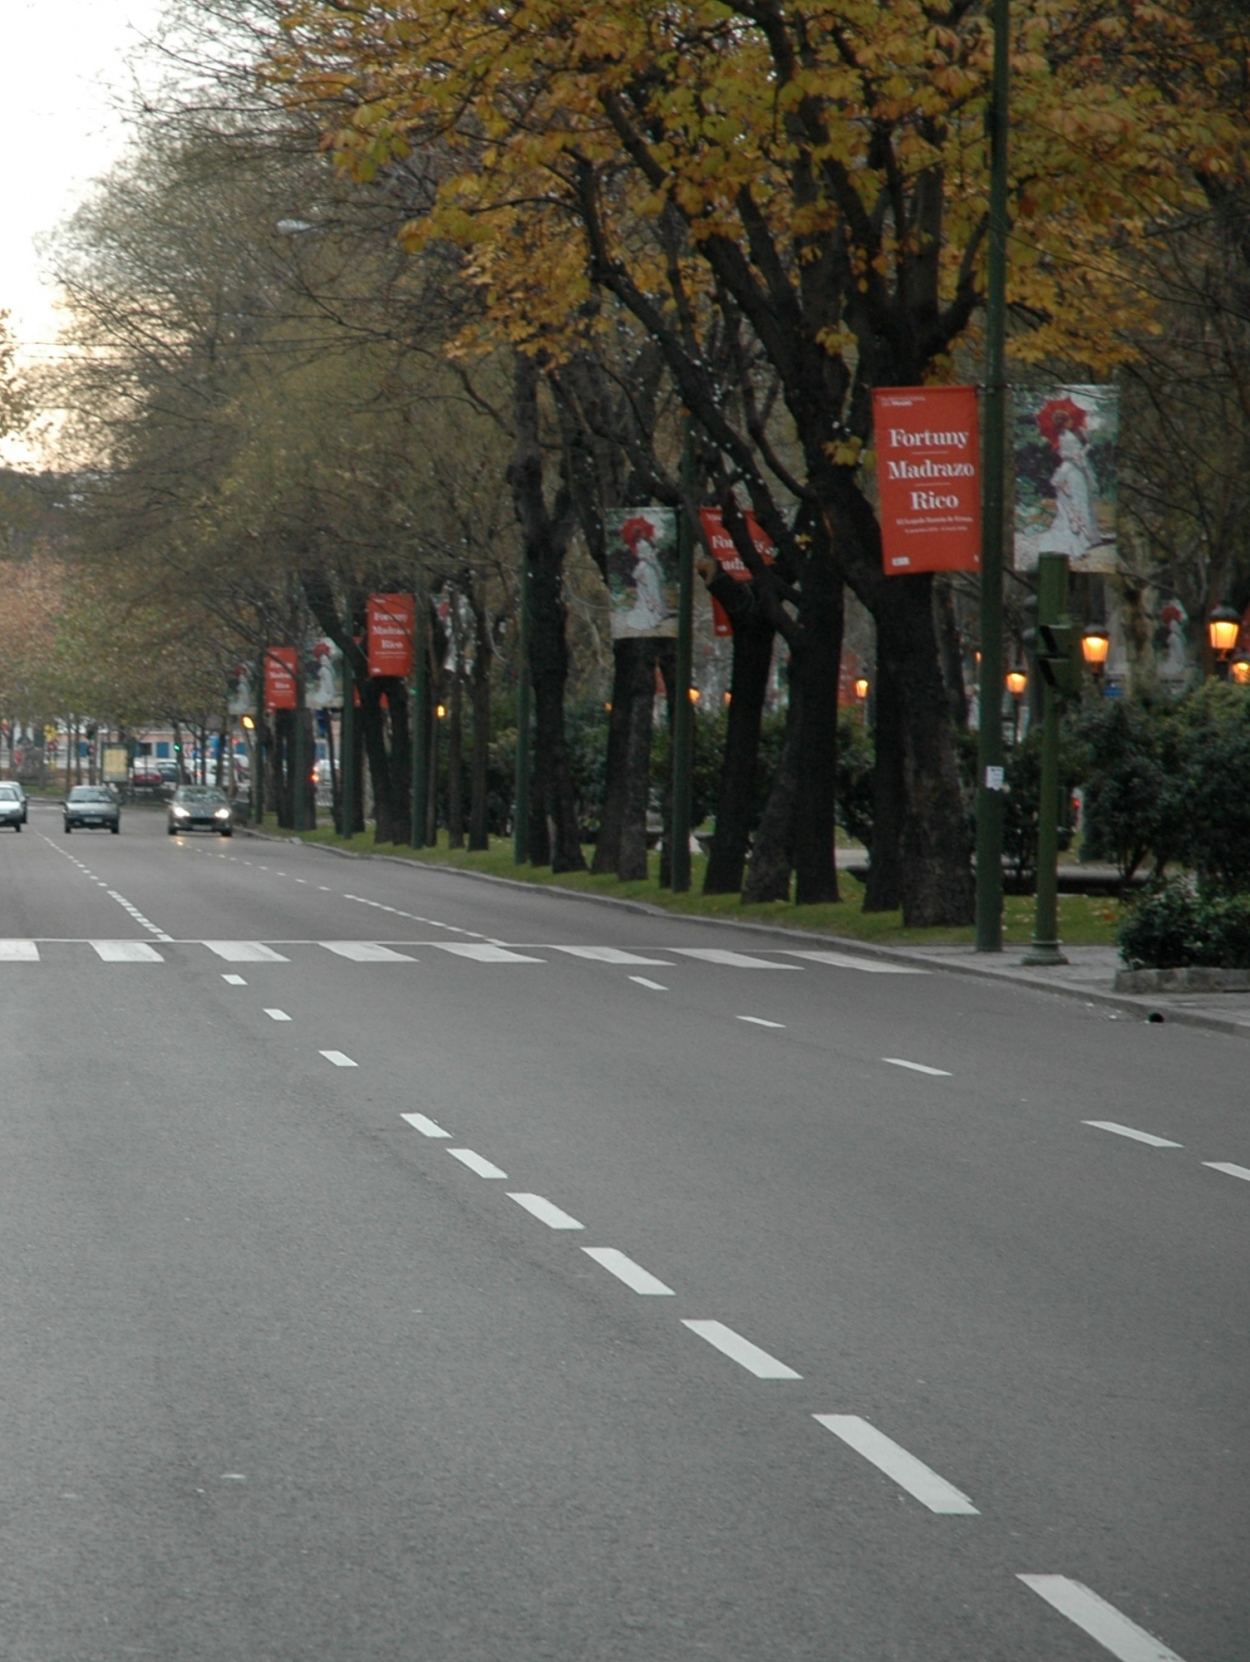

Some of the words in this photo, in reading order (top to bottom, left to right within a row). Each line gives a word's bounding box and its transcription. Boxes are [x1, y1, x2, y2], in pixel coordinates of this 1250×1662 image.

[889, 428, 969, 449] Fortuny
[887, 459, 975, 480] Madrazo
[910, 491, 959, 510] Rico
